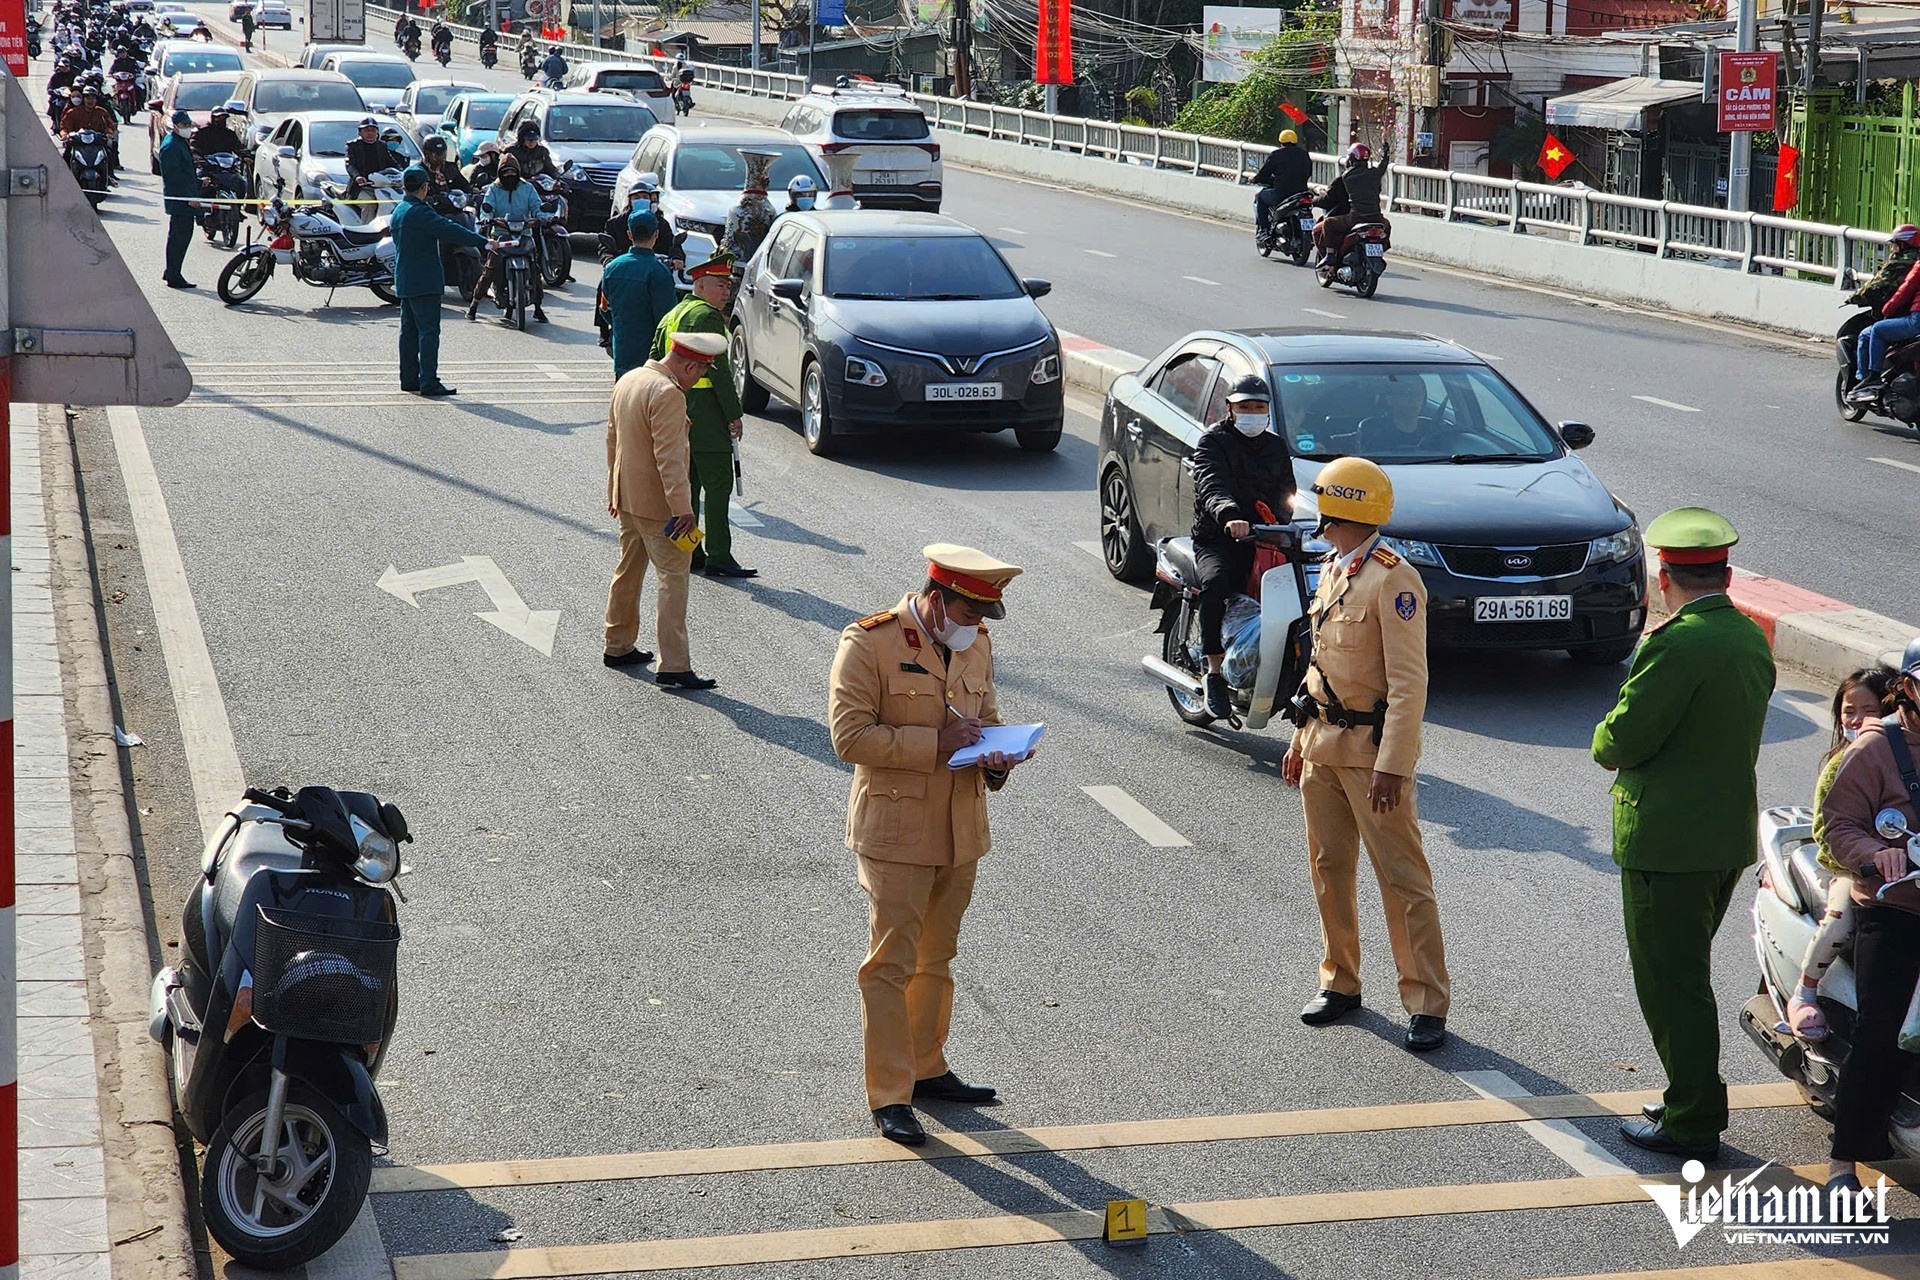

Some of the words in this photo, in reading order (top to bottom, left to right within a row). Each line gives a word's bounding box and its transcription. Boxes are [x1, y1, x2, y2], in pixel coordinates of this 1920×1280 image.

[1725, 84, 1771, 101] CẤM
[932, 386, 996, 398] 30L-028.63
[1325, 484, 1366, 501] CSGT
[1477, 599, 1569, 619] 29A-561.69
[305, 888, 350, 900] HONDA
[1116, 1204, 1136, 1233] 1
